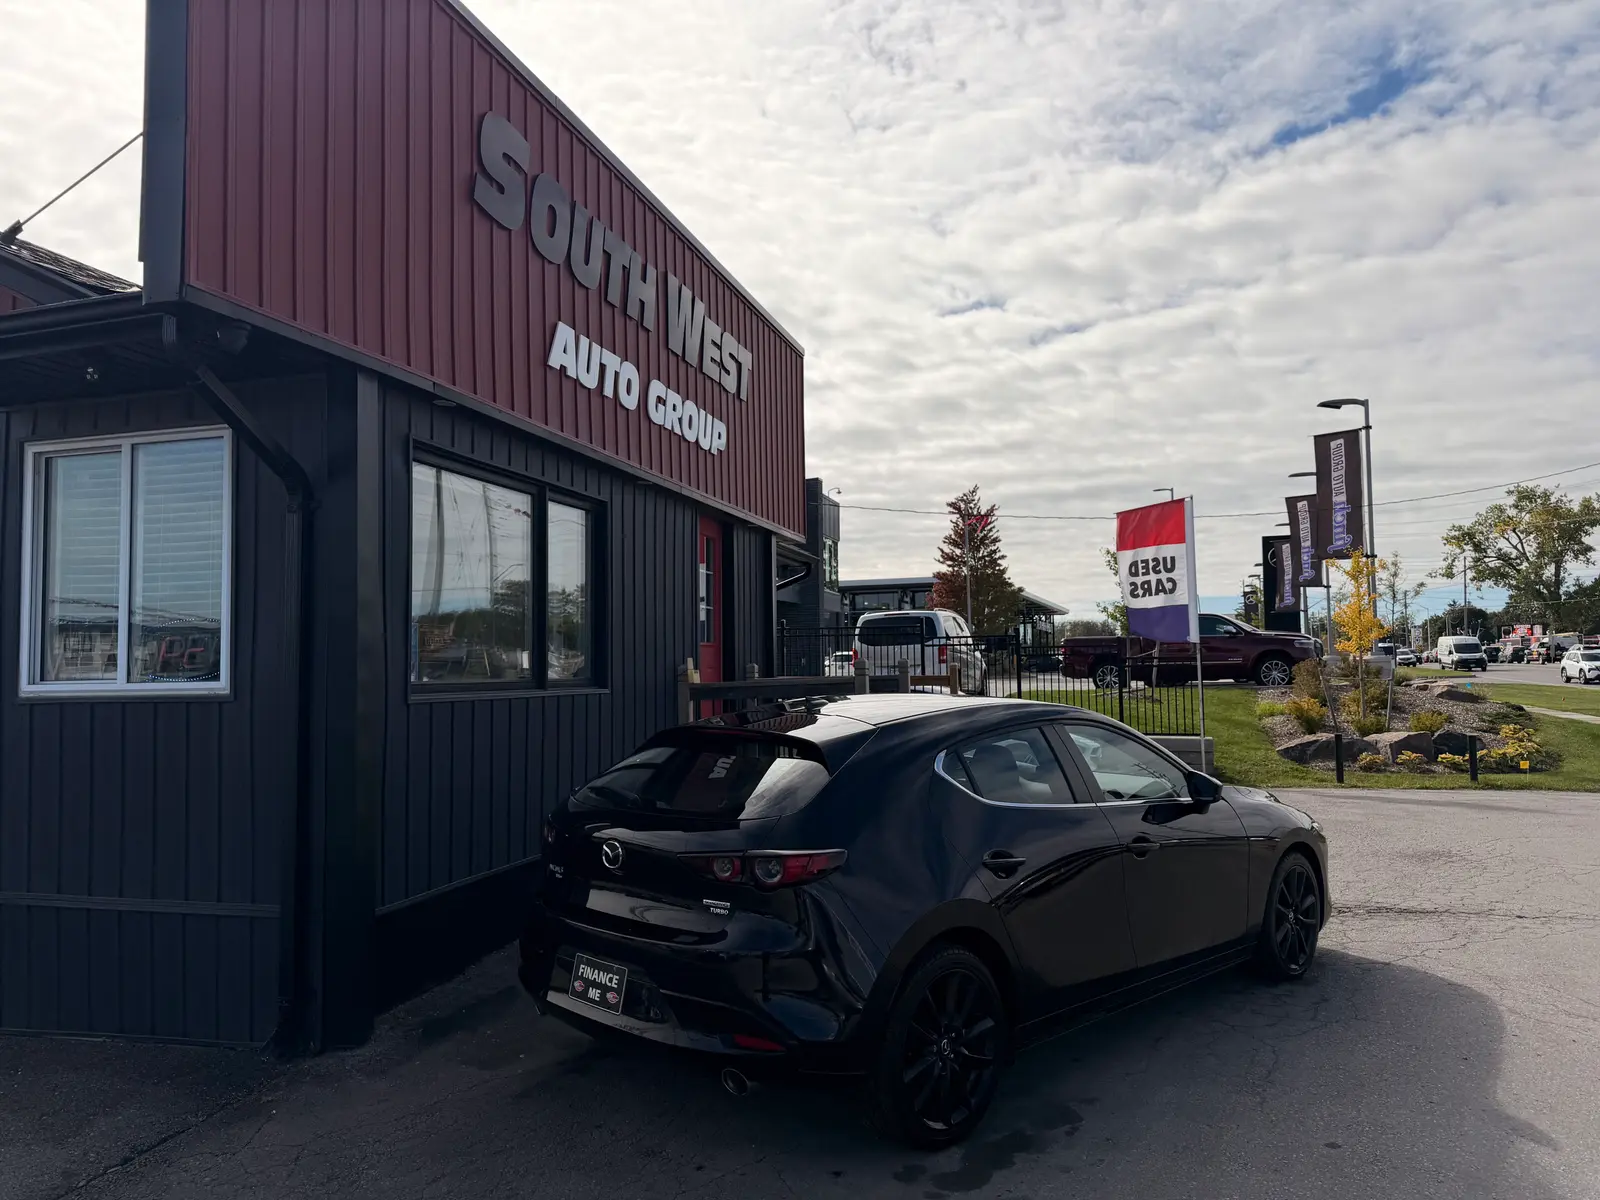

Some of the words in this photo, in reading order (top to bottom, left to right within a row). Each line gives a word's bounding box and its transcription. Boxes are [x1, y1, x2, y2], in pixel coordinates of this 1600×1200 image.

[473, 110, 657, 332] SOUTH
[666, 270, 752, 402] WEST
[546, 321, 640, 411] AUTO
[647, 379, 727, 455] GROUP
[709, 907, 729, 915] TURBO
[578, 963, 620, 989] FINANCE
[587, 986, 602, 1001] ME
